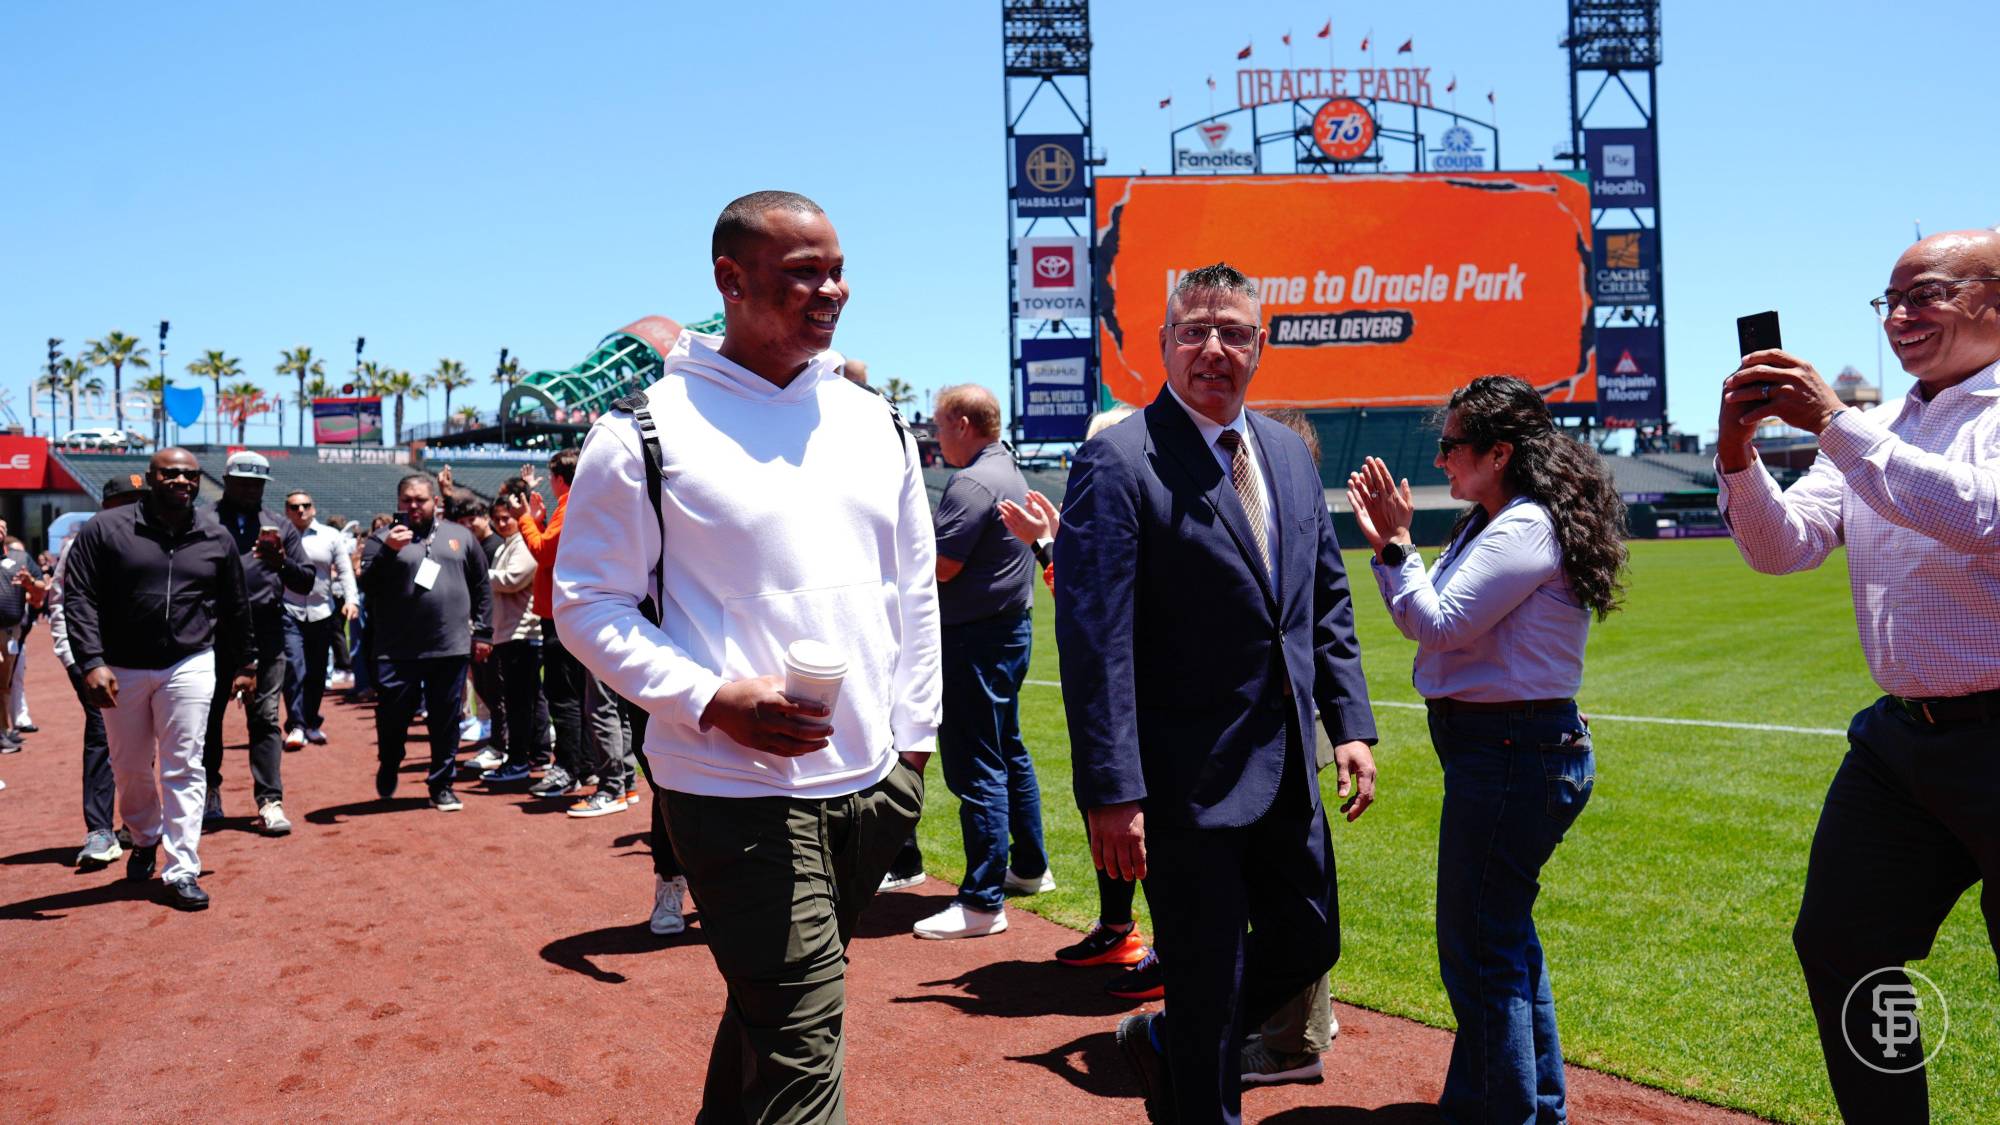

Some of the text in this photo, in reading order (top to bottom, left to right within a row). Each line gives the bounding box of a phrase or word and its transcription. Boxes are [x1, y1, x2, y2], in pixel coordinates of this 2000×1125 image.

[1237, 67, 1433, 109] ORACLE PARK
[1325, 115, 1363, 144] 76
[1178, 150, 1254, 168] Fanatics
[1434, 152, 1484, 171] coupa
[1594, 179, 1646, 195] Health
[1061, 196, 1084, 207] LAW
[1313, 270, 1346, 303] to
[1351, 265, 1449, 303] Oracle
[1454, 263, 1526, 301] Park
[1597, 269, 1650, 281] CACHE
[1024, 297, 1086, 310] TOYOTA
[1278, 317, 1404, 342] RAFAEL DEVERS
[1597, 374, 1657, 390] Benjamin
[31, 380, 150, 420] blue
[1606, 389, 1649, 401] Moore
